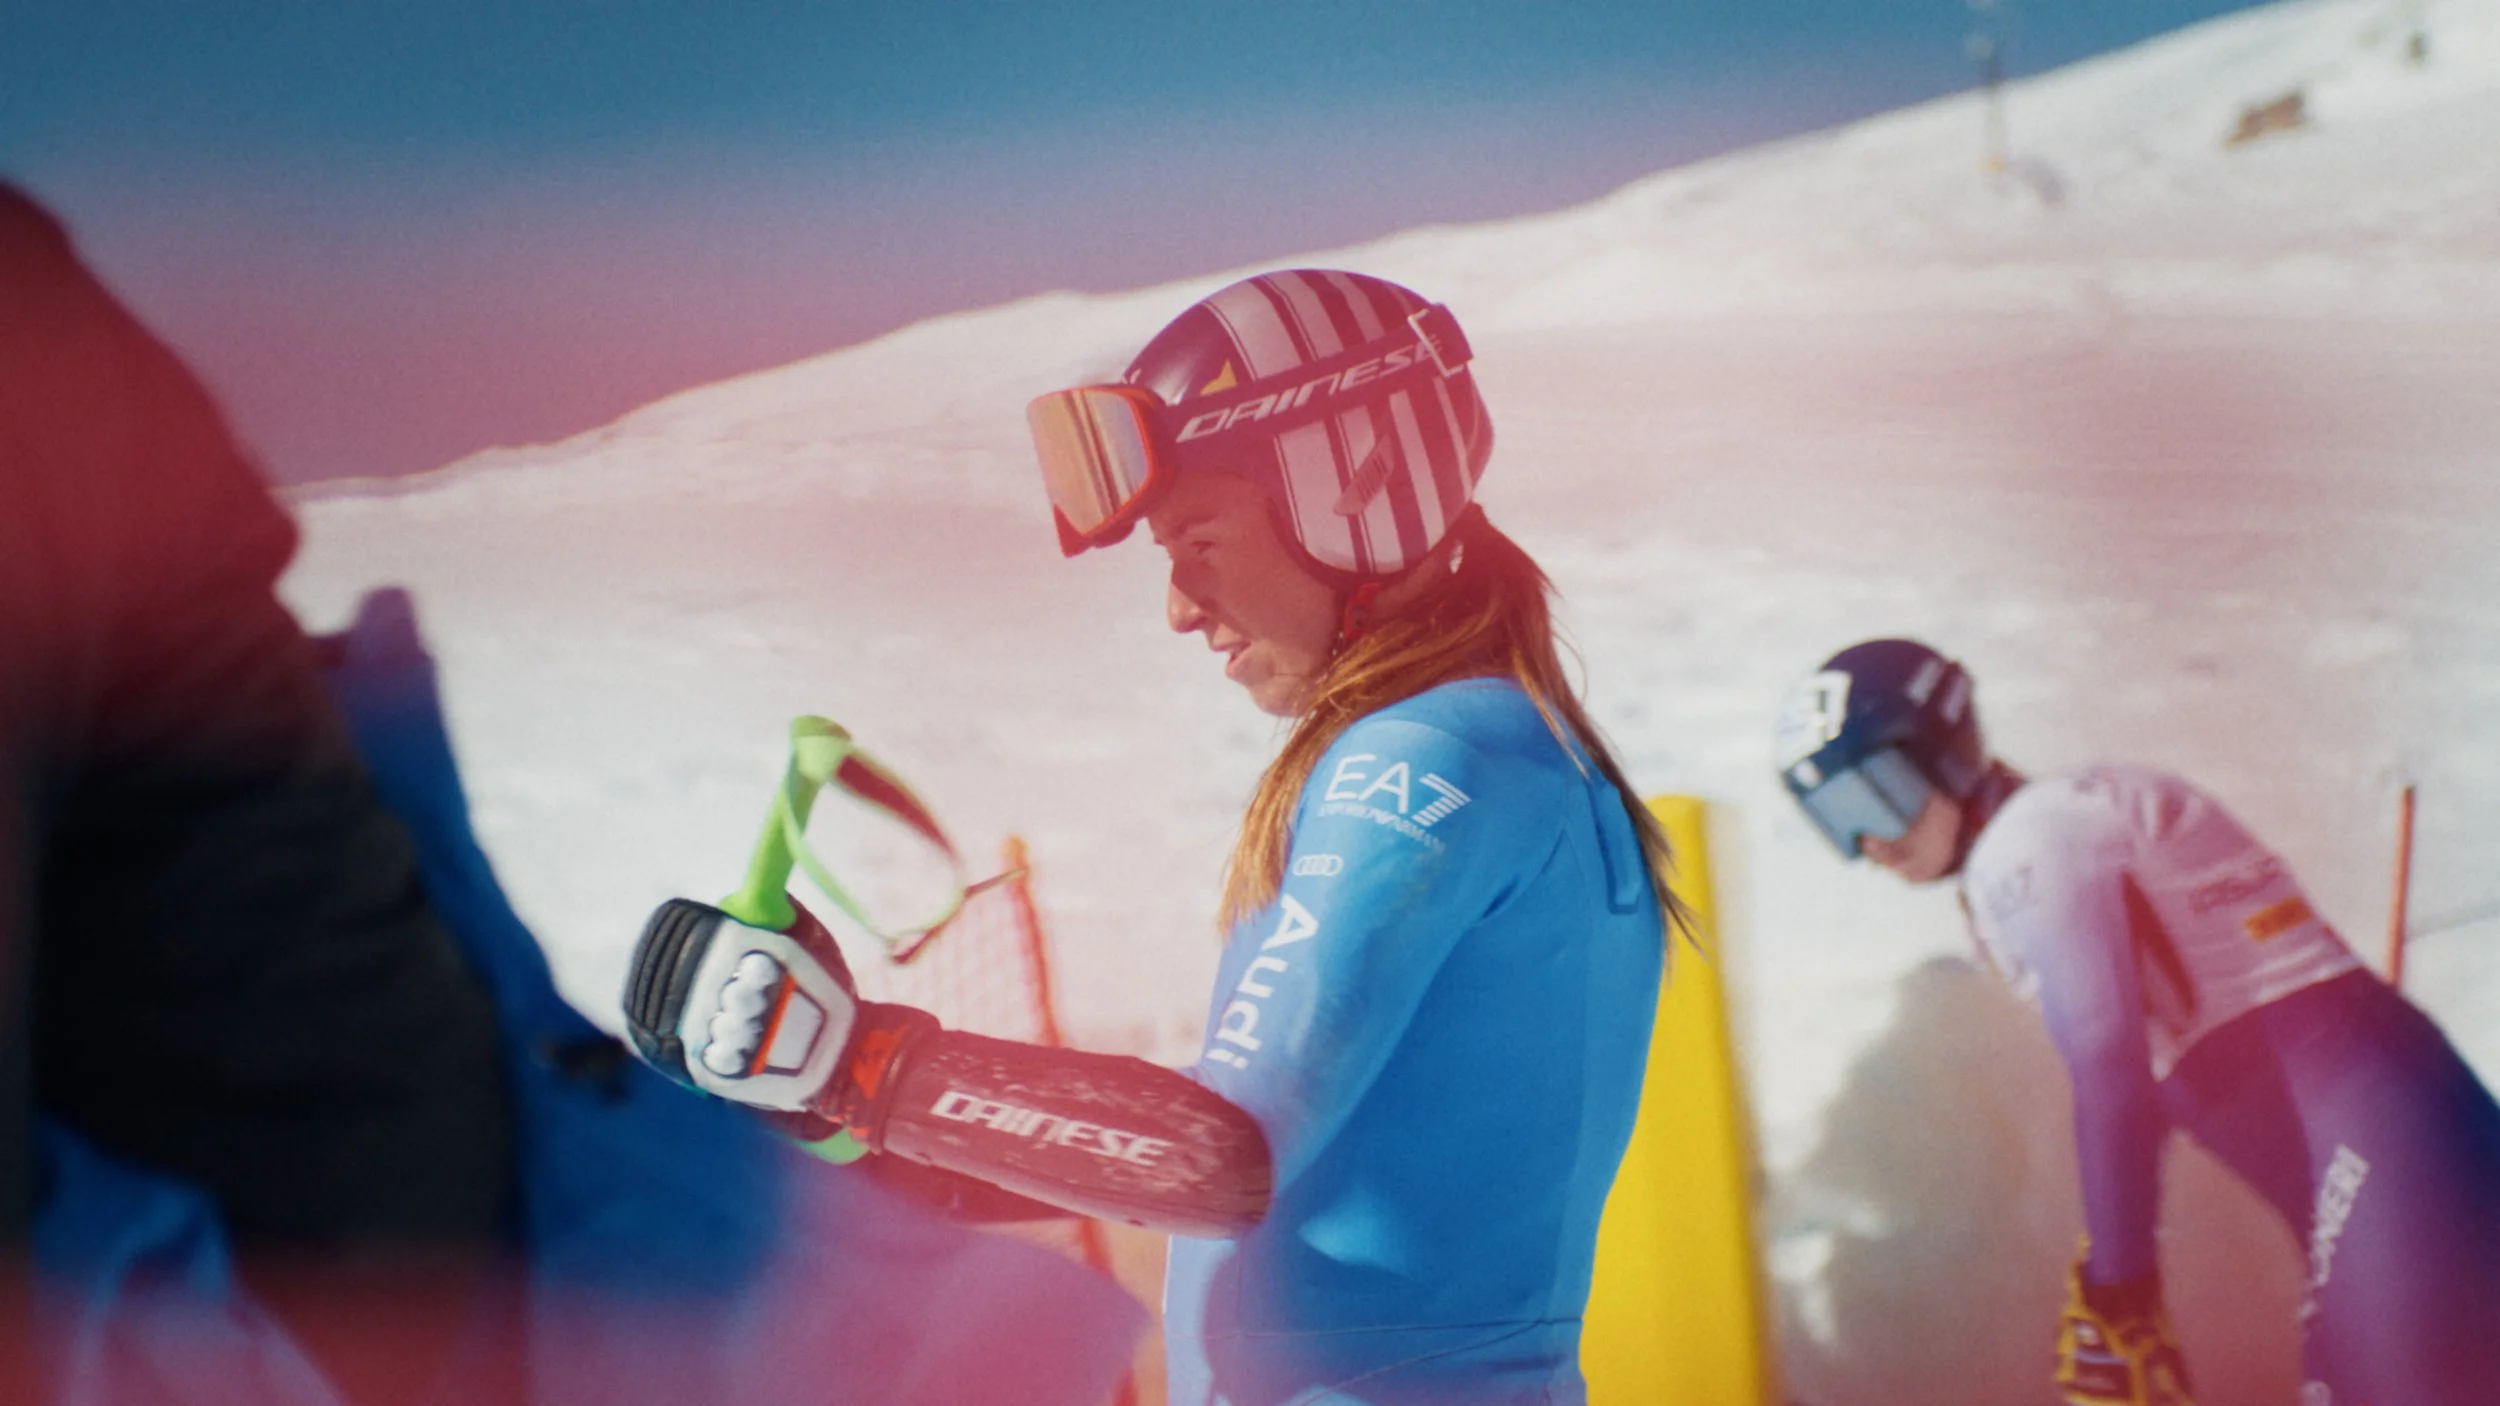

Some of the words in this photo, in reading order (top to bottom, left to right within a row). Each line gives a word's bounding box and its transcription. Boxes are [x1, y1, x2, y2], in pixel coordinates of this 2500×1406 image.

[1176, 333, 1442, 443] DAINESE
[1324, 753, 1473, 828] EA7
[1206, 893, 1320, 1070] Audi
[930, 1090, 1173, 1167] DAINESE
